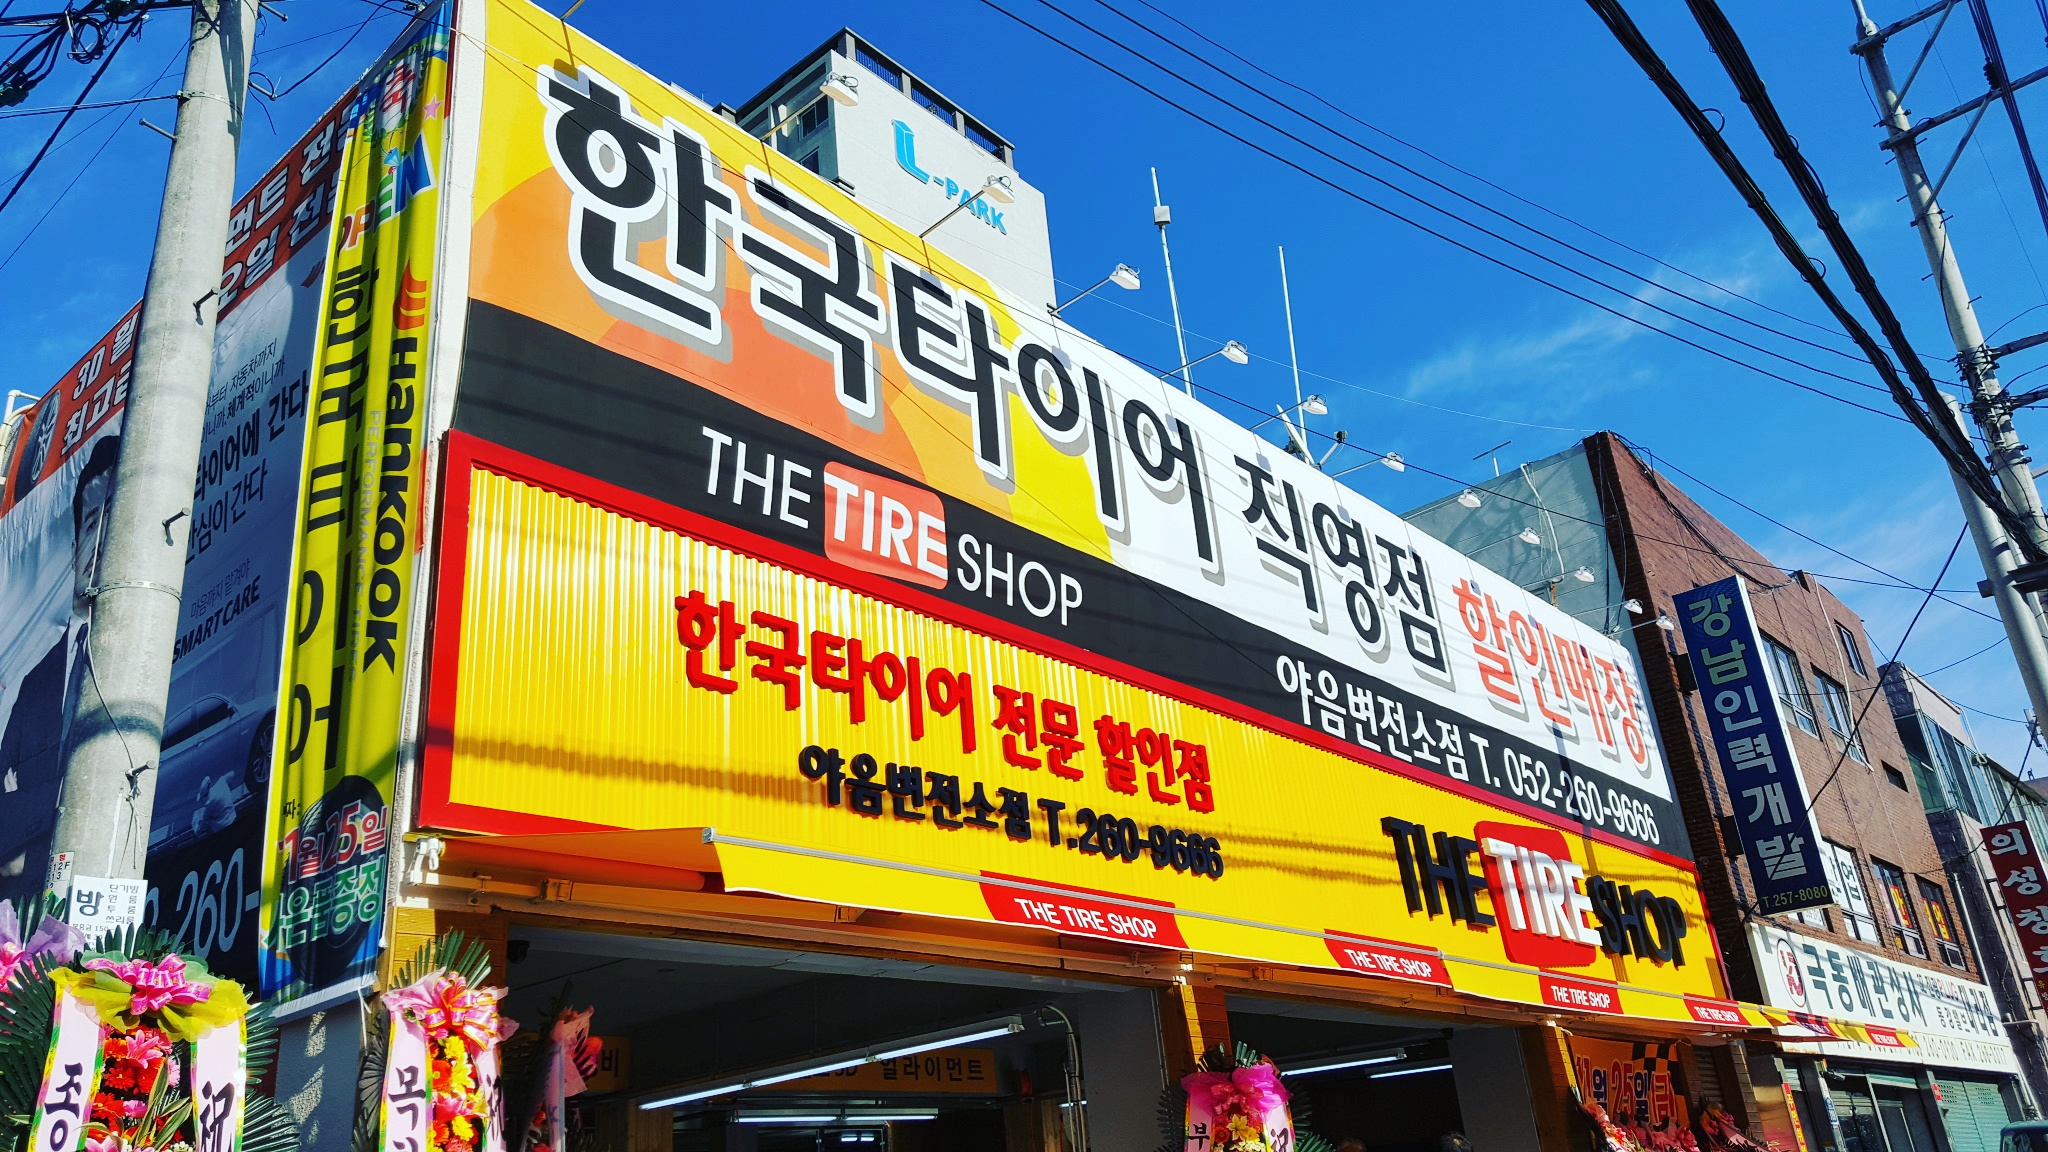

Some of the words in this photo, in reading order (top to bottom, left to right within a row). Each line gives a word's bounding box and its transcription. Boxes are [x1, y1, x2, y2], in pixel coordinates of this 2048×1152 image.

[891, 119, 1007, 235] L-PARK
[72, 344, 106, 401] 3D
[230, 337, 277, 392] 자동차까지
[267, 369, 309, 442] 간다
[544, 70, 1222, 566] 한국타이어
[1233, 454, 1447, 674] 직영점
[1452, 577, 1646, 764] 할인매장
[363, 337, 418, 675] Hankook
[702, 427, 812, 529] THE
[824, 471, 948, 580] TIRE
[957, 533, 1082, 625] SHOP
[675, 590, 976, 753] 한국타이어
[992, 684, 1085, 780] 전문
[1093, 714, 1215, 813] 할인점
[1688, 593, 1807, 880] 강남인력개발
[799, 743, 1033, 840] 야음변전소점
[1276, 655, 1469, 780] 야음변전소점
[1504, 747, 1659, 845] 052-260-9666
[77, 889, 104, 916] 방
[1014, 898, 1061, 924] THE
[1059, 905, 1108, 931] TIRE
[1107, 913, 1157, 938] SHOP
[1381, 816, 1496, 930] THE
[1481, 837, 1602, 947] TIRE
[1585, 874, 1687, 968] SHOP
[1762, 886, 1828, 909] T.257-8080
[1344, 949, 1376, 968] THE
[1371, 953, 1403, 973] TIRE
[1400, 958, 1432, 977] SHOP
[1551, 985, 1570, 1003] THE
[1569, 988, 1589, 1006] TIRE
[1588, 991, 1611, 1008] SHOP
[1802, 943, 1928, 1027] 극동배관상사
[388, 1065, 426, 1152] 목
[880, 1056, 984, 1082] 얼라이먼트
